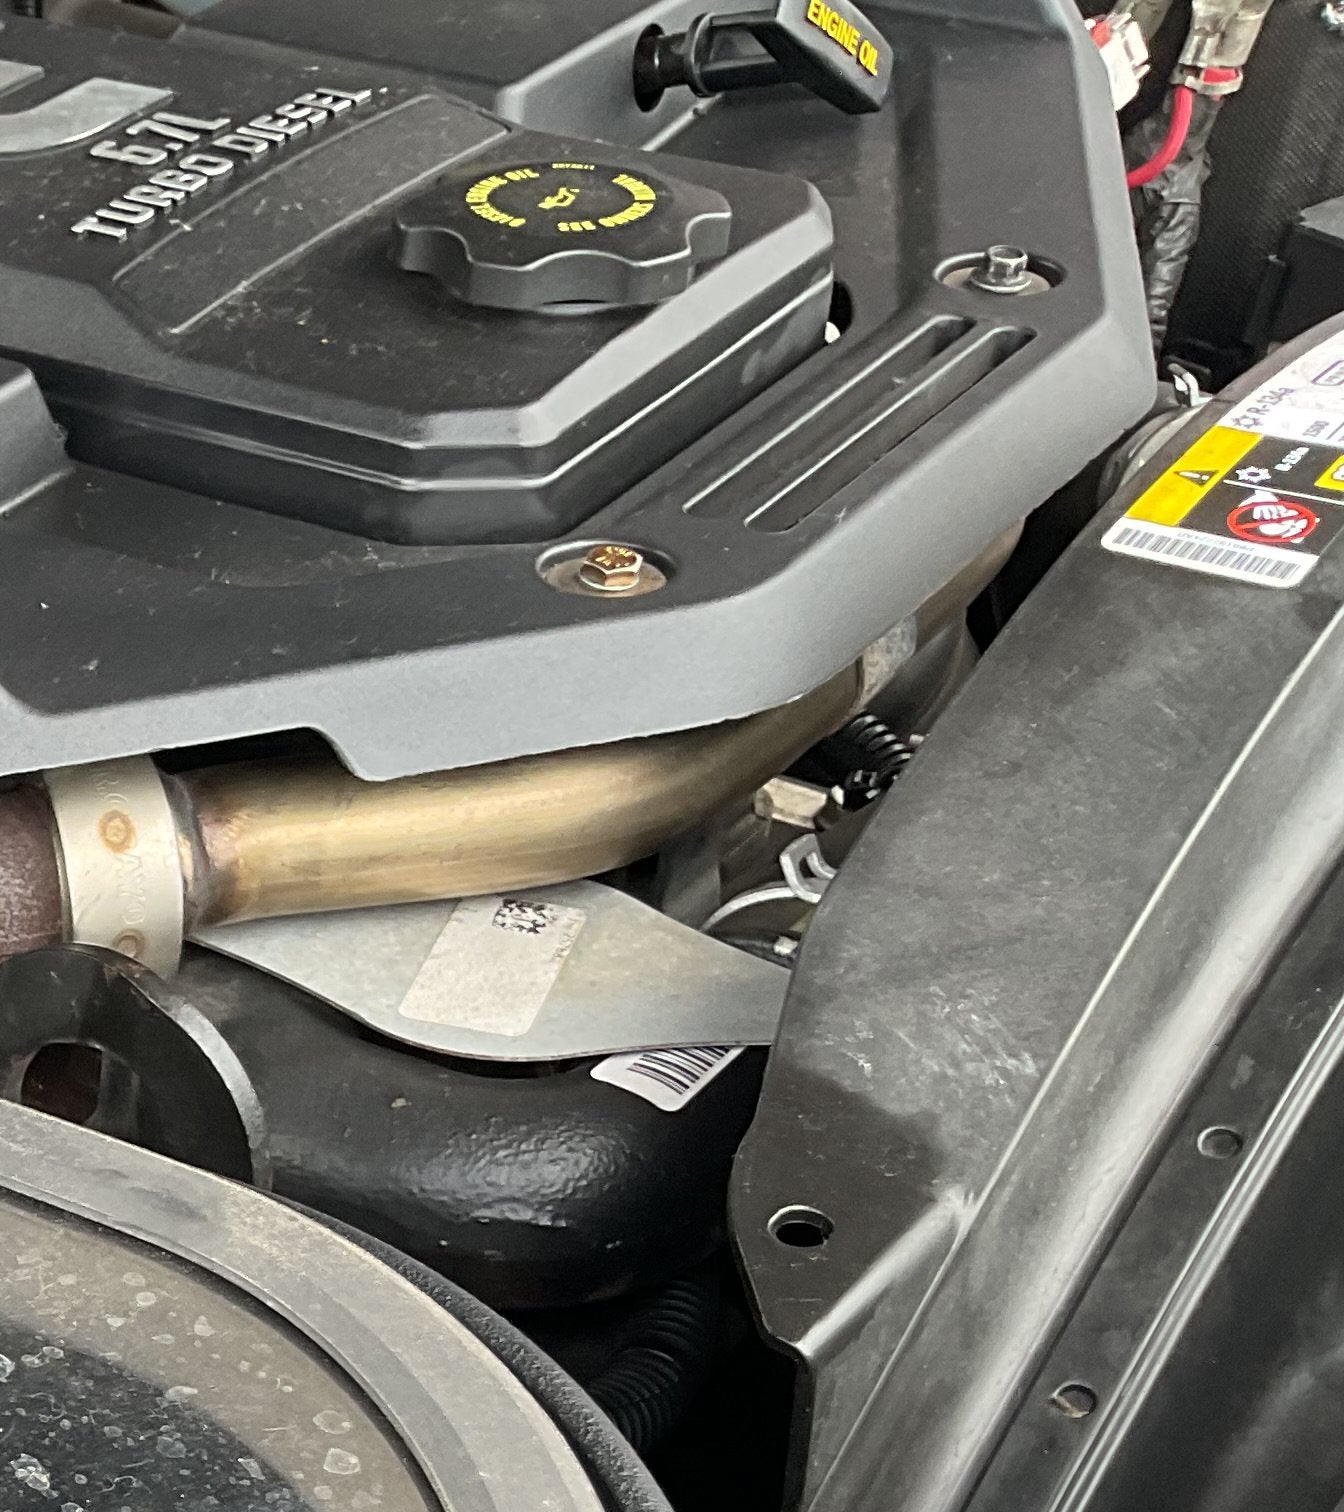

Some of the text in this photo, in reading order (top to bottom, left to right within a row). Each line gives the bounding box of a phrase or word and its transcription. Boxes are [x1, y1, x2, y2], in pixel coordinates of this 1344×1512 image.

[807, 0, 878, 76] ENGINE OIL
[69, 86, 373, 238] TURBO DIESEL
[89, 111, 232, 166] 6.7L
